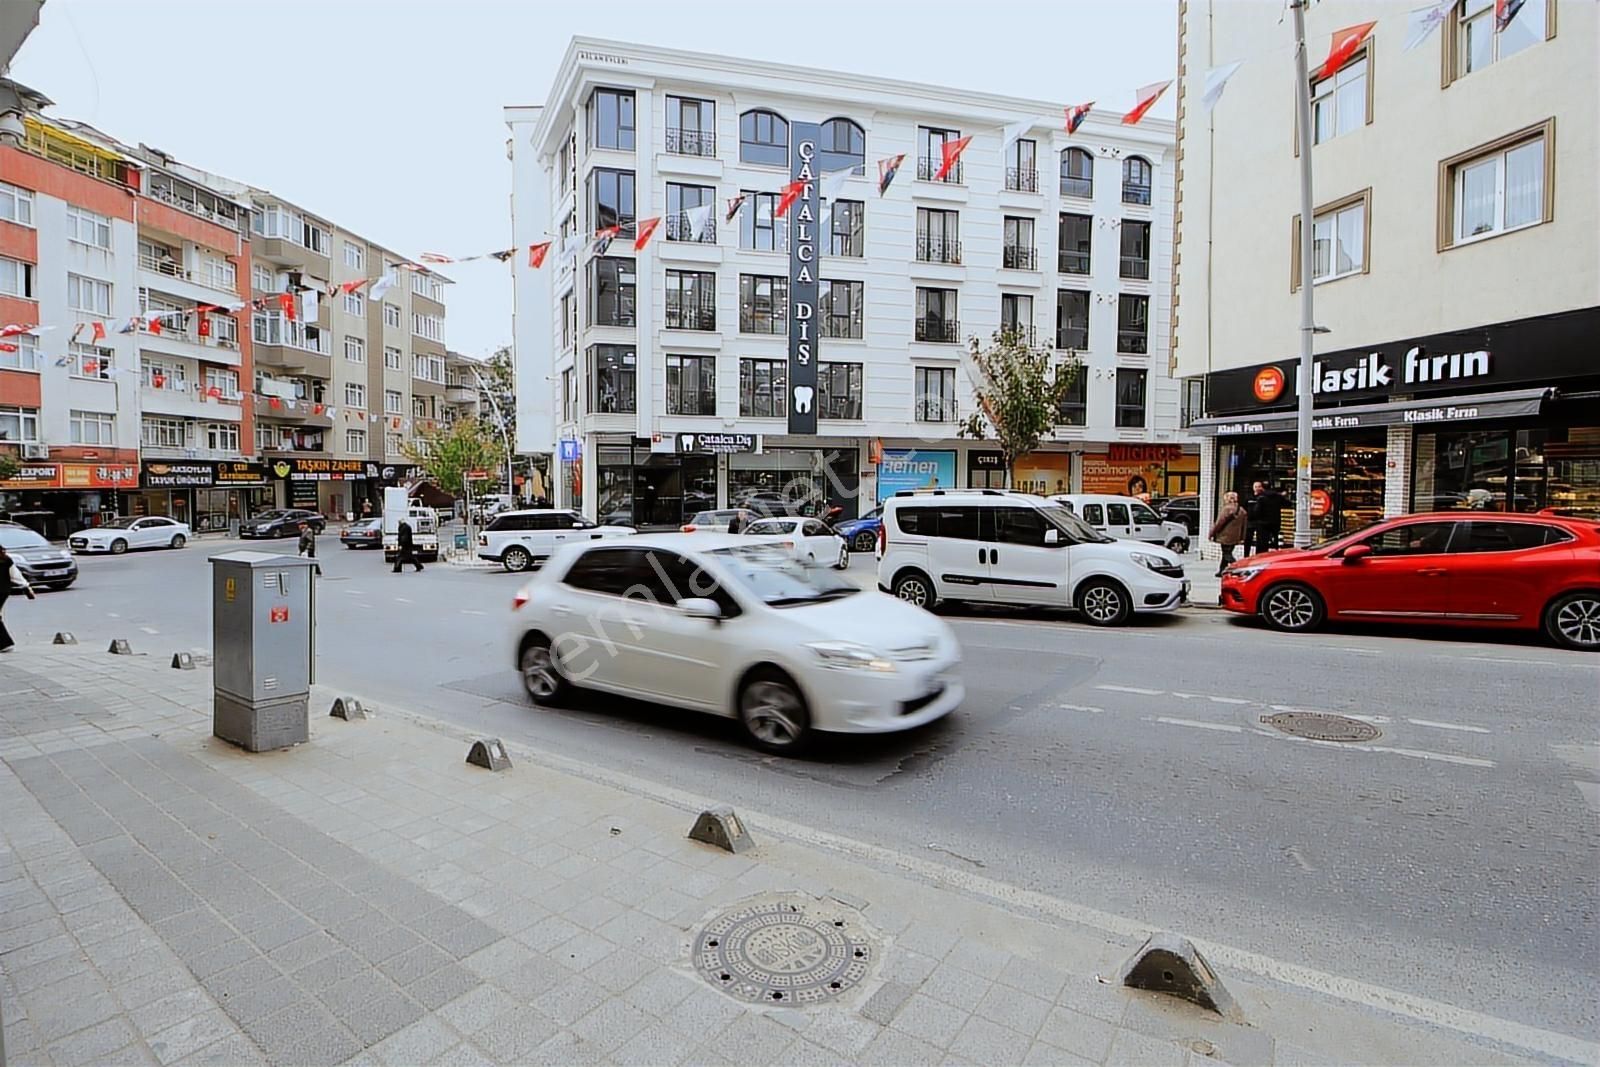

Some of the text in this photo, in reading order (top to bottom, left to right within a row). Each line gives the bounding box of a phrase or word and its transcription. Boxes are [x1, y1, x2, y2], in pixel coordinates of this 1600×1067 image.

[795, 142, 815, 366] ÇATALCA DİŞ
[1404, 346, 1489, 384] fırın
[1404, 407, 1478, 421] Klasik Fırın
[1217, 423, 1263, 434] Klasik Fırın
[1312, 416, 1359, 428] asik Fırın
[698, 433, 752, 447] Çatalca Diş
[296, 459, 330, 472] TAŞKIN
[332, 459, 361, 471] ZAHİRE
[882, 460, 938, 474] Hemen
[1083, 463, 1143, 475] sanalmarket
[150, 476, 175, 485] TAVUK
